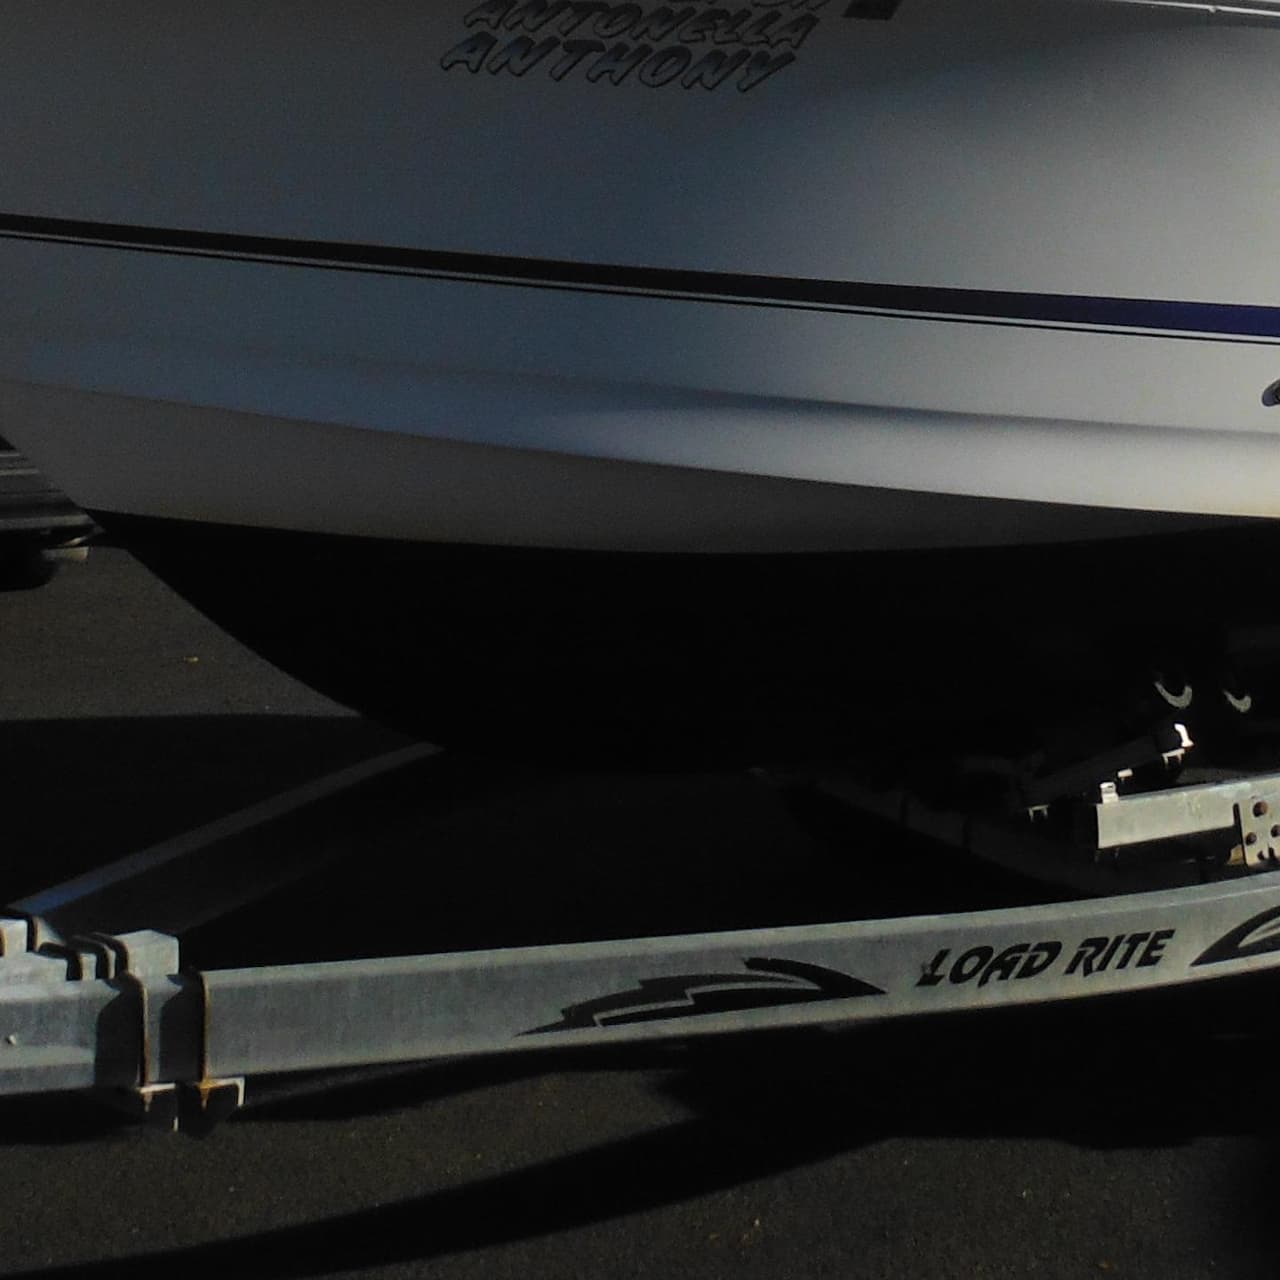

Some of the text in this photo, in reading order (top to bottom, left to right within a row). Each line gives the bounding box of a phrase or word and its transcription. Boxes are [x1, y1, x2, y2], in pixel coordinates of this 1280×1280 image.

[439, 31, 797, 94] ANTHONY
[915, 929, 1176, 989] LOAD RITE
